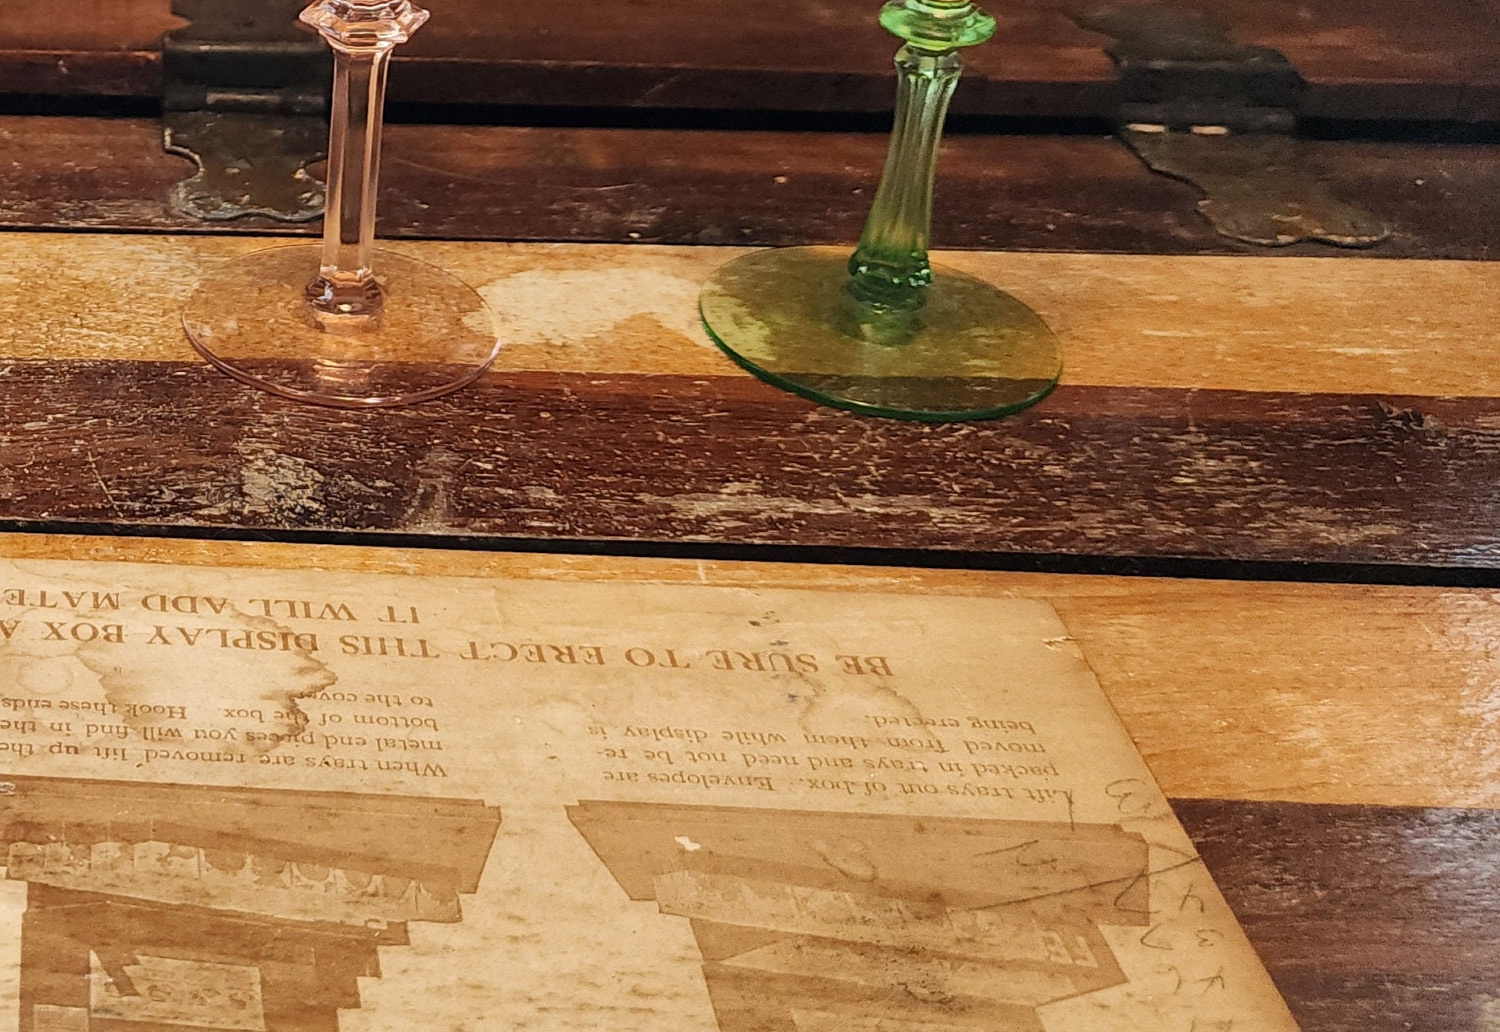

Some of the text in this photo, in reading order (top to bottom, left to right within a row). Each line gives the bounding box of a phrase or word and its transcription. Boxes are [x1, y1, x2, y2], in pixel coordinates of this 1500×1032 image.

[140, 593, 230, 616] ADD
[247, 596, 359, 623] WILL
[375, 604, 422, 625] IT
[39, 620, 126, 645] BOX
[144, 623, 319, 654] DISPLAY
[337, 633, 441, 660] THIS
[458, 640, 604, 667] ERECT
[622, 645, 692, 670] TO
[704, 648, 820, 675] SURE
[833, 653, 896, 678] BE
[0, 696, 53, 714] ends
[57, 698, 119, 717] these
[364, 692, 403, 709] the
[408, 693, 434, 709] to
[124, 702, 188, 720] Hook
[316, 711, 344, 728] of
[47, 720, 73, 737] in
[84, 722, 131, 739] find
[351, 712, 439, 732] bottom
[965, 715, 1034, 736] being
[141, 725, 184, 742] will
[193, 724, 238, 743] you
[324, 733, 368, 750] end
[622, 724, 709, 744] display
[720, 729, 788, 747] while
[801, 732, 868, 750] them
[47, 741, 80, 758] up
[93, 745, 129, 762] lift
[374, 736, 444, 753] metal
[887, 735, 947, 754] from
[962, 738, 1046, 756] moved
[144, 748, 247, 766] removed
[260, 753, 297, 768] are
[304, 753, 369, 774] trays
[641, 748, 673, 765] be
[684, 750, 728, 766] not
[738, 751, 799, 769] need
[805, 754, 853, 772] and
[863, 755, 928, 775] trays
[376, 758, 448, 779] When
[600, 770, 640, 785] are
[936, 761, 964, 779] in
[972, 759, 1059, 782] packed
[644, 768, 775, 792] Envelopes
[862, 780, 888, 796] of
[898, 781, 940, 797] out
[948, 779, 1014, 800] trays
